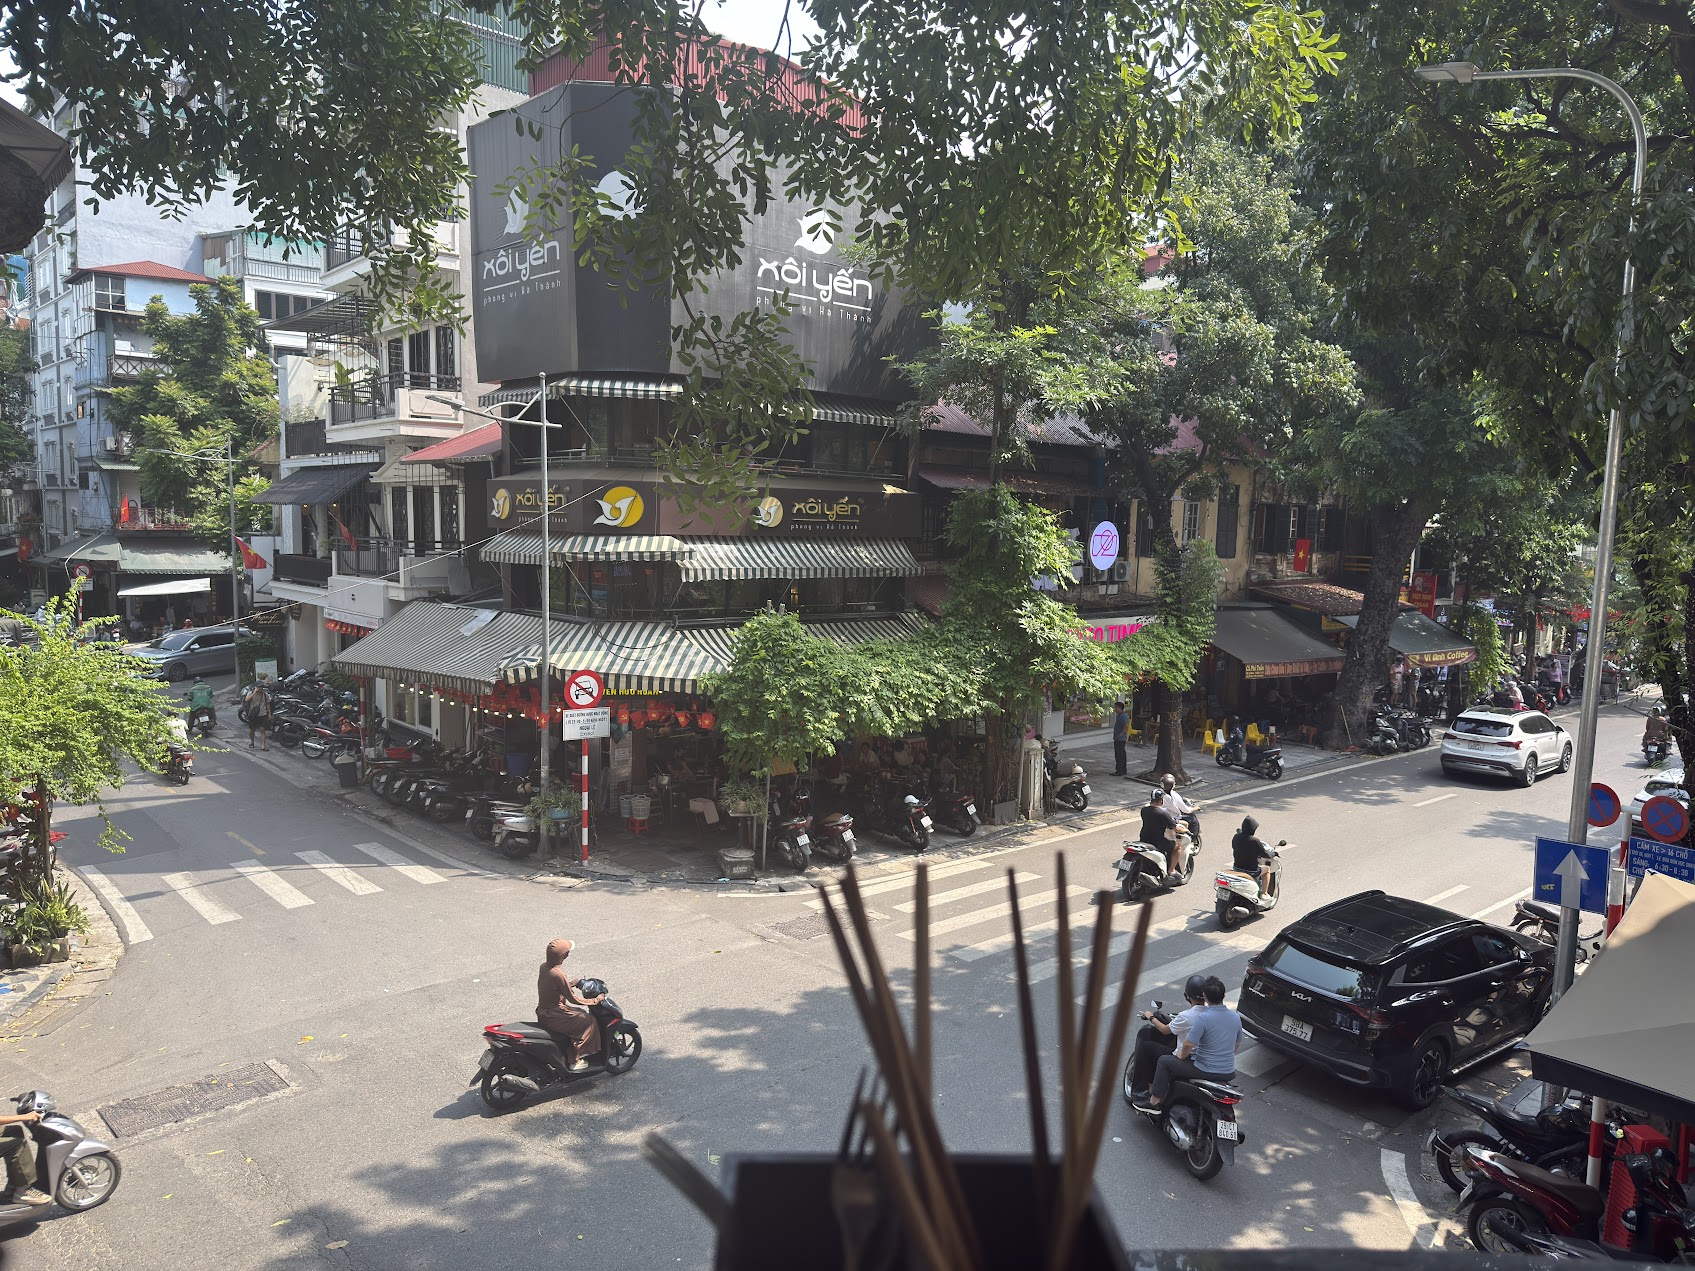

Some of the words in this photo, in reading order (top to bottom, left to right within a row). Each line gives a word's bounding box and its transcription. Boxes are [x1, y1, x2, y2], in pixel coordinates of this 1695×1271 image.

[483, 248, 512, 280] xôi
[515, 232, 560, 281] yến
[757, 256, 806, 287] xôi
[812, 266, 872, 303] yến
[792, 497, 821, 514] xôi
[824, 495, 860, 521] yến
[1447, 650, 1469, 660] Coffee
[1651, 845, 1660, 853] XE
